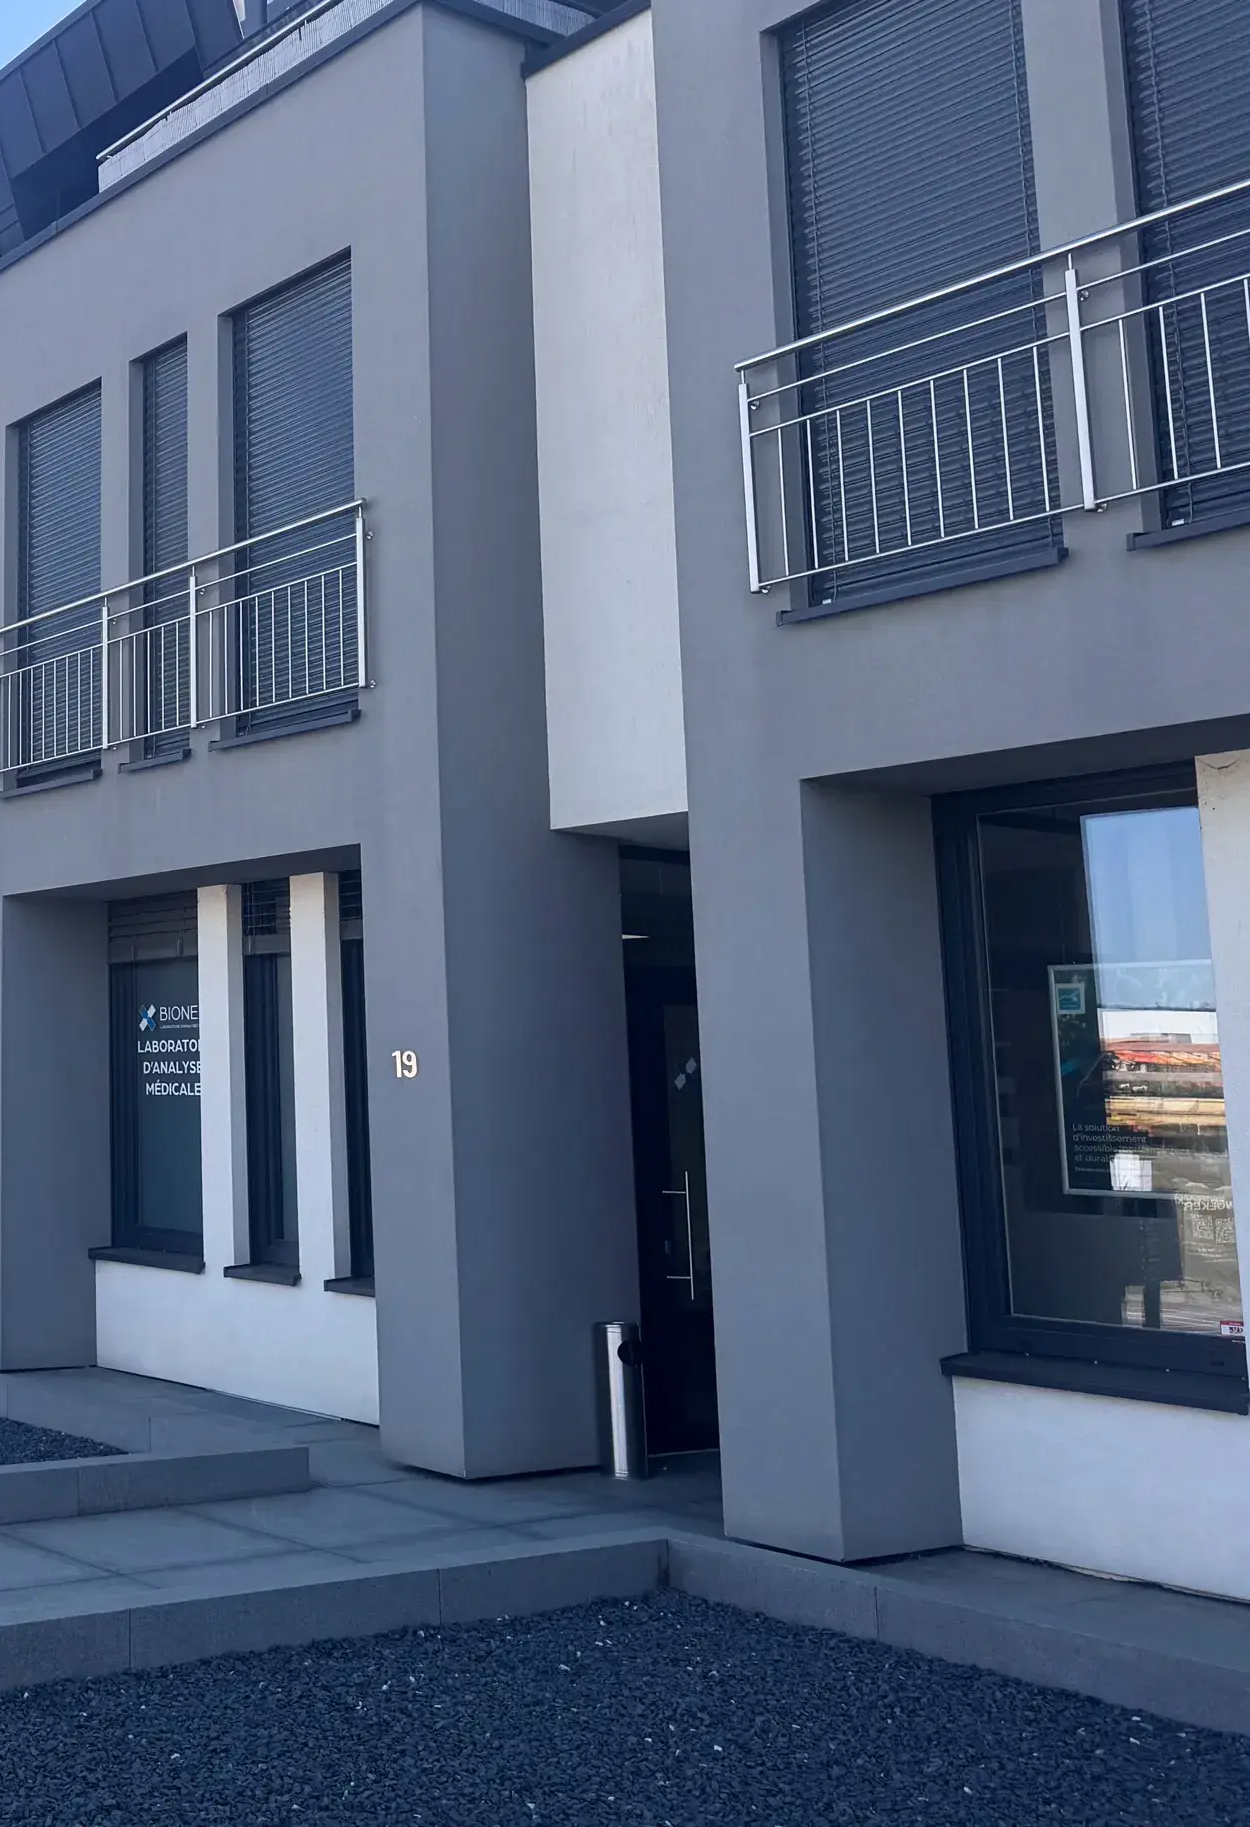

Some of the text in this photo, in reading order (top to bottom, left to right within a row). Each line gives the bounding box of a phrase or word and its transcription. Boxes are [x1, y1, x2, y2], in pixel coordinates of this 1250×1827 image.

[159, 1005, 198, 1020] BIONE
[391, 1050, 418, 1078] 19
[146, 1079, 202, 1095] MÉDICALE
[1084, 1123, 1120, 1132] solution
